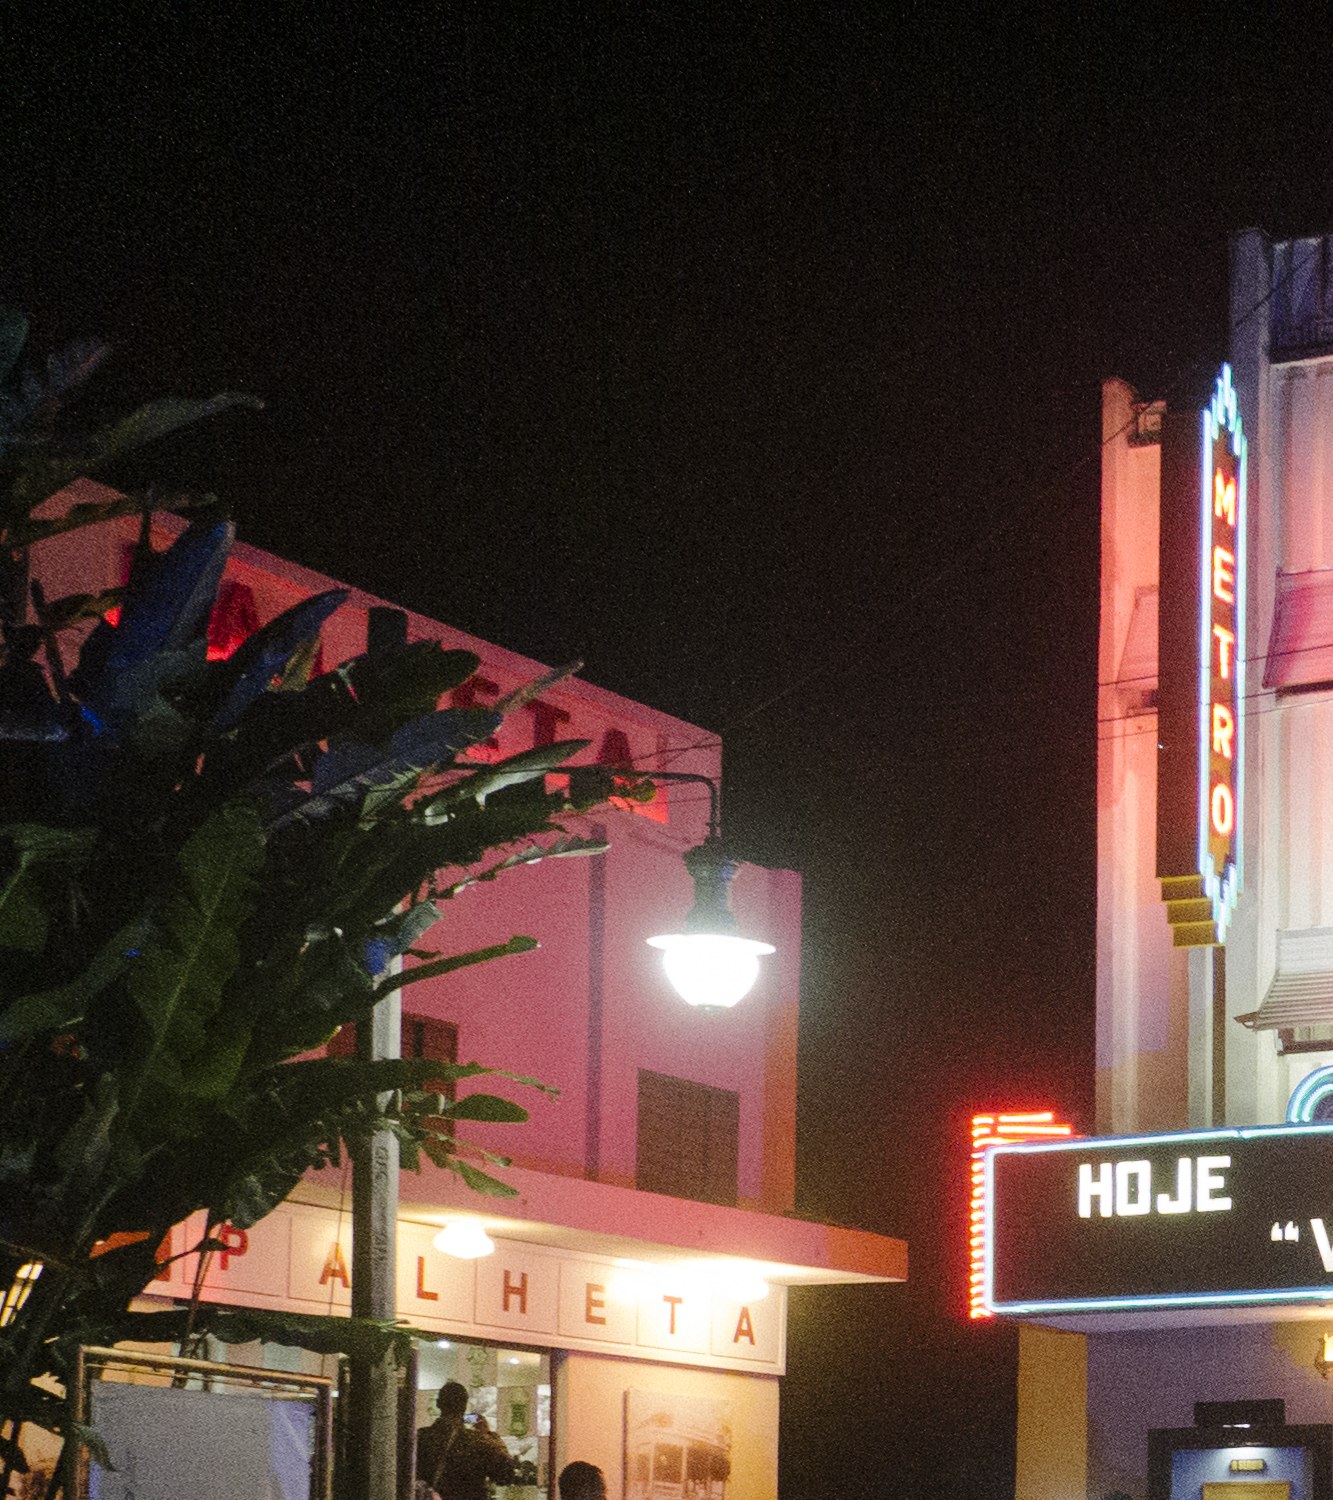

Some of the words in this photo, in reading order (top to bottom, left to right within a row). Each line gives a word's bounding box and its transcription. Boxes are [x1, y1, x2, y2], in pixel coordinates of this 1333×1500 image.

[1211, 467, 1237, 837] METRO
[1077, 1155, 1233, 1219] HOJE
[218, 1222, 757, 1347] PALHETA
